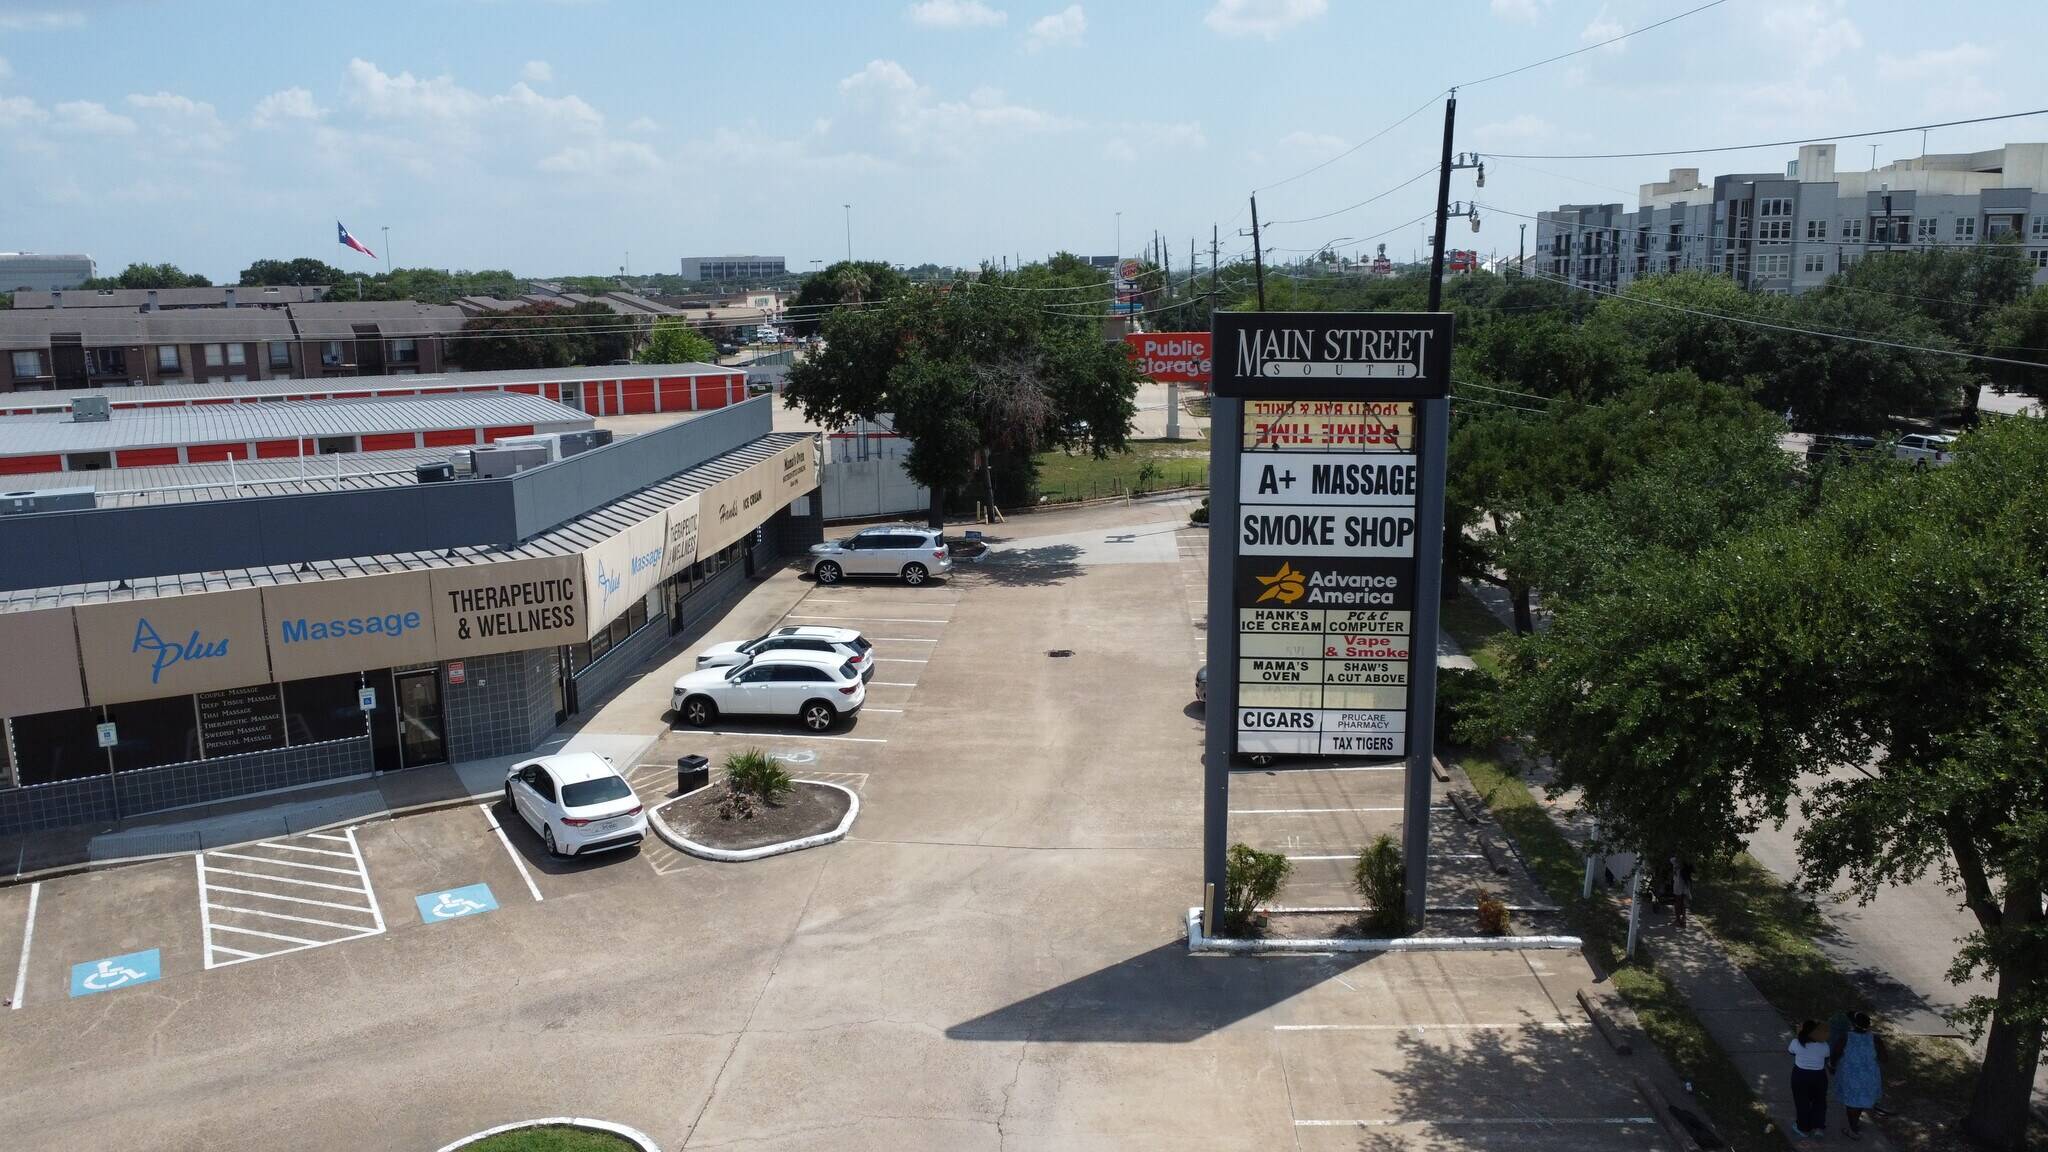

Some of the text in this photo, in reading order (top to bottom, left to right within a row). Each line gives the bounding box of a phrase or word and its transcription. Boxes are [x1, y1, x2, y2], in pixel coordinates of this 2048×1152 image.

[1145, 341, 1204, 356] Public
[1235, 329, 1433, 378] MAIN STREET
[1137, 358, 1211, 376] Storage
[1273, 364, 1405, 376] SOUTH
[1300, 403, 1309, 415] &
[1314, 403, 1343, 415] BAR
[1255, 424, 1398, 444] PRIME TIME
[1258, 465, 1416, 495] A+ MASSAGE
[1243, 515, 1415, 547] SMOKE SHOP
[631, 547, 662, 576] Massage
[1308, 571, 1397, 588] Advance
[448, 578, 574, 613] THERAPEUTIC
[1307, 588, 1393, 604] America
[458, 604, 575, 640] & WELLNESS
[1255, 611, 1308, 620] HANK'S
[1347, 612, 1389, 620] PC & C
[282, 611, 421, 644] Massage
[1241, 621, 1321, 631] ICE CREAM
[1329, 622, 1404, 632] COMPUTER
[1344, 634, 1391, 647] Vape
[1325, 646, 1408, 657] & Smoke
[1253, 661, 1309, 671] MAMA'S
[1344, 663, 1388, 672] SHAW'S
[1262, 671, 1300, 681] OVEN
[1327, 674, 1405, 683] A CUT ABOVE
[1243, 711, 1314, 728] CIGARS
[1341, 714, 1386, 722] PRUCARE
[1337, 721, 1390, 729] PHARMACY
[1333, 737, 1394, 750] TAX TIGERS
